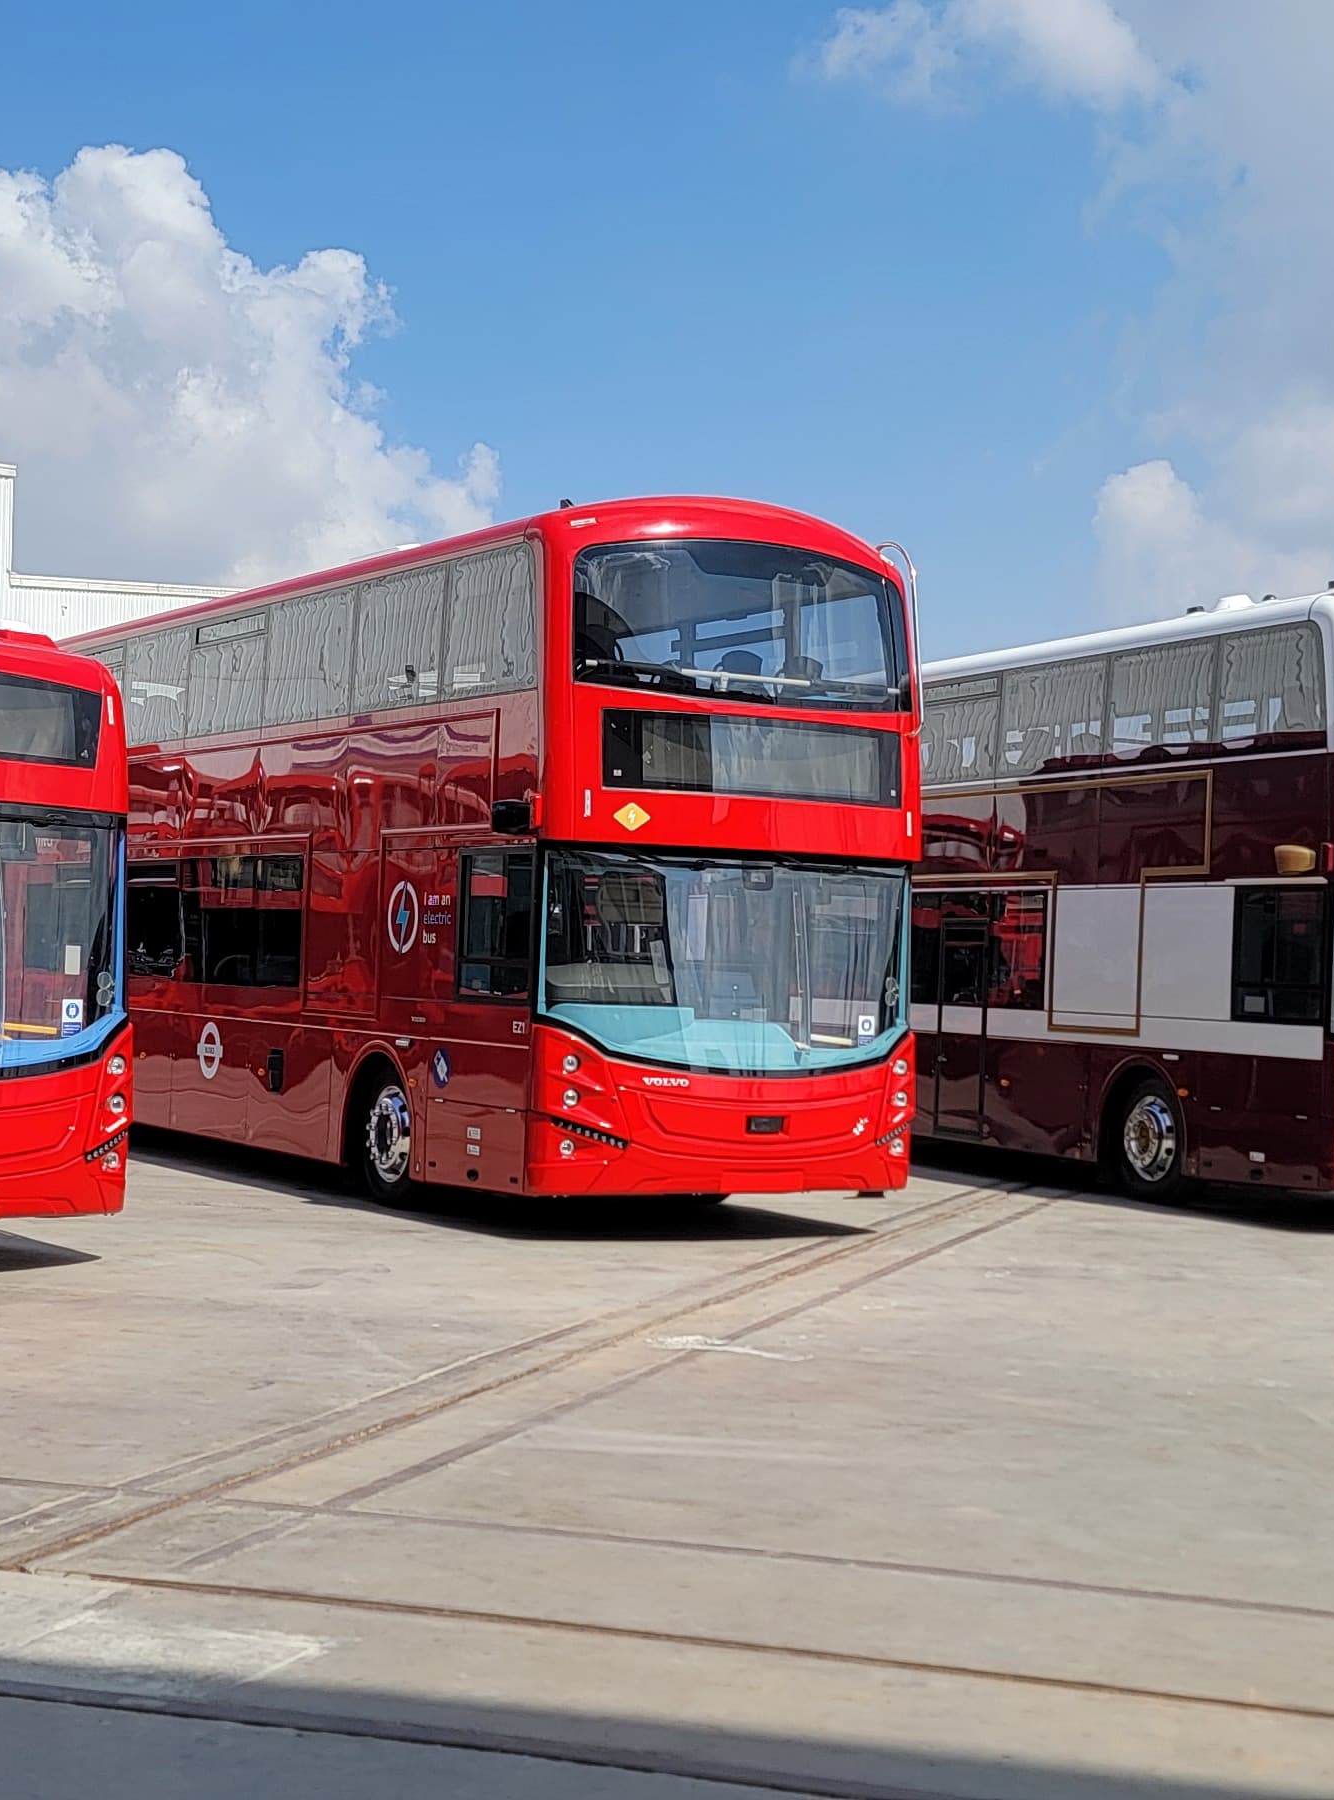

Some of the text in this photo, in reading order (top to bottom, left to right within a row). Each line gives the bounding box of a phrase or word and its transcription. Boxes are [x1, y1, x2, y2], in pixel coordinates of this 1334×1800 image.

[428, 895, 440, 906] am
[441, 894, 451, 906] an
[423, 910, 452, 925] electric
[422, 929, 437, 944] bus
[642, 1076, 690, 1088] VOLVO
